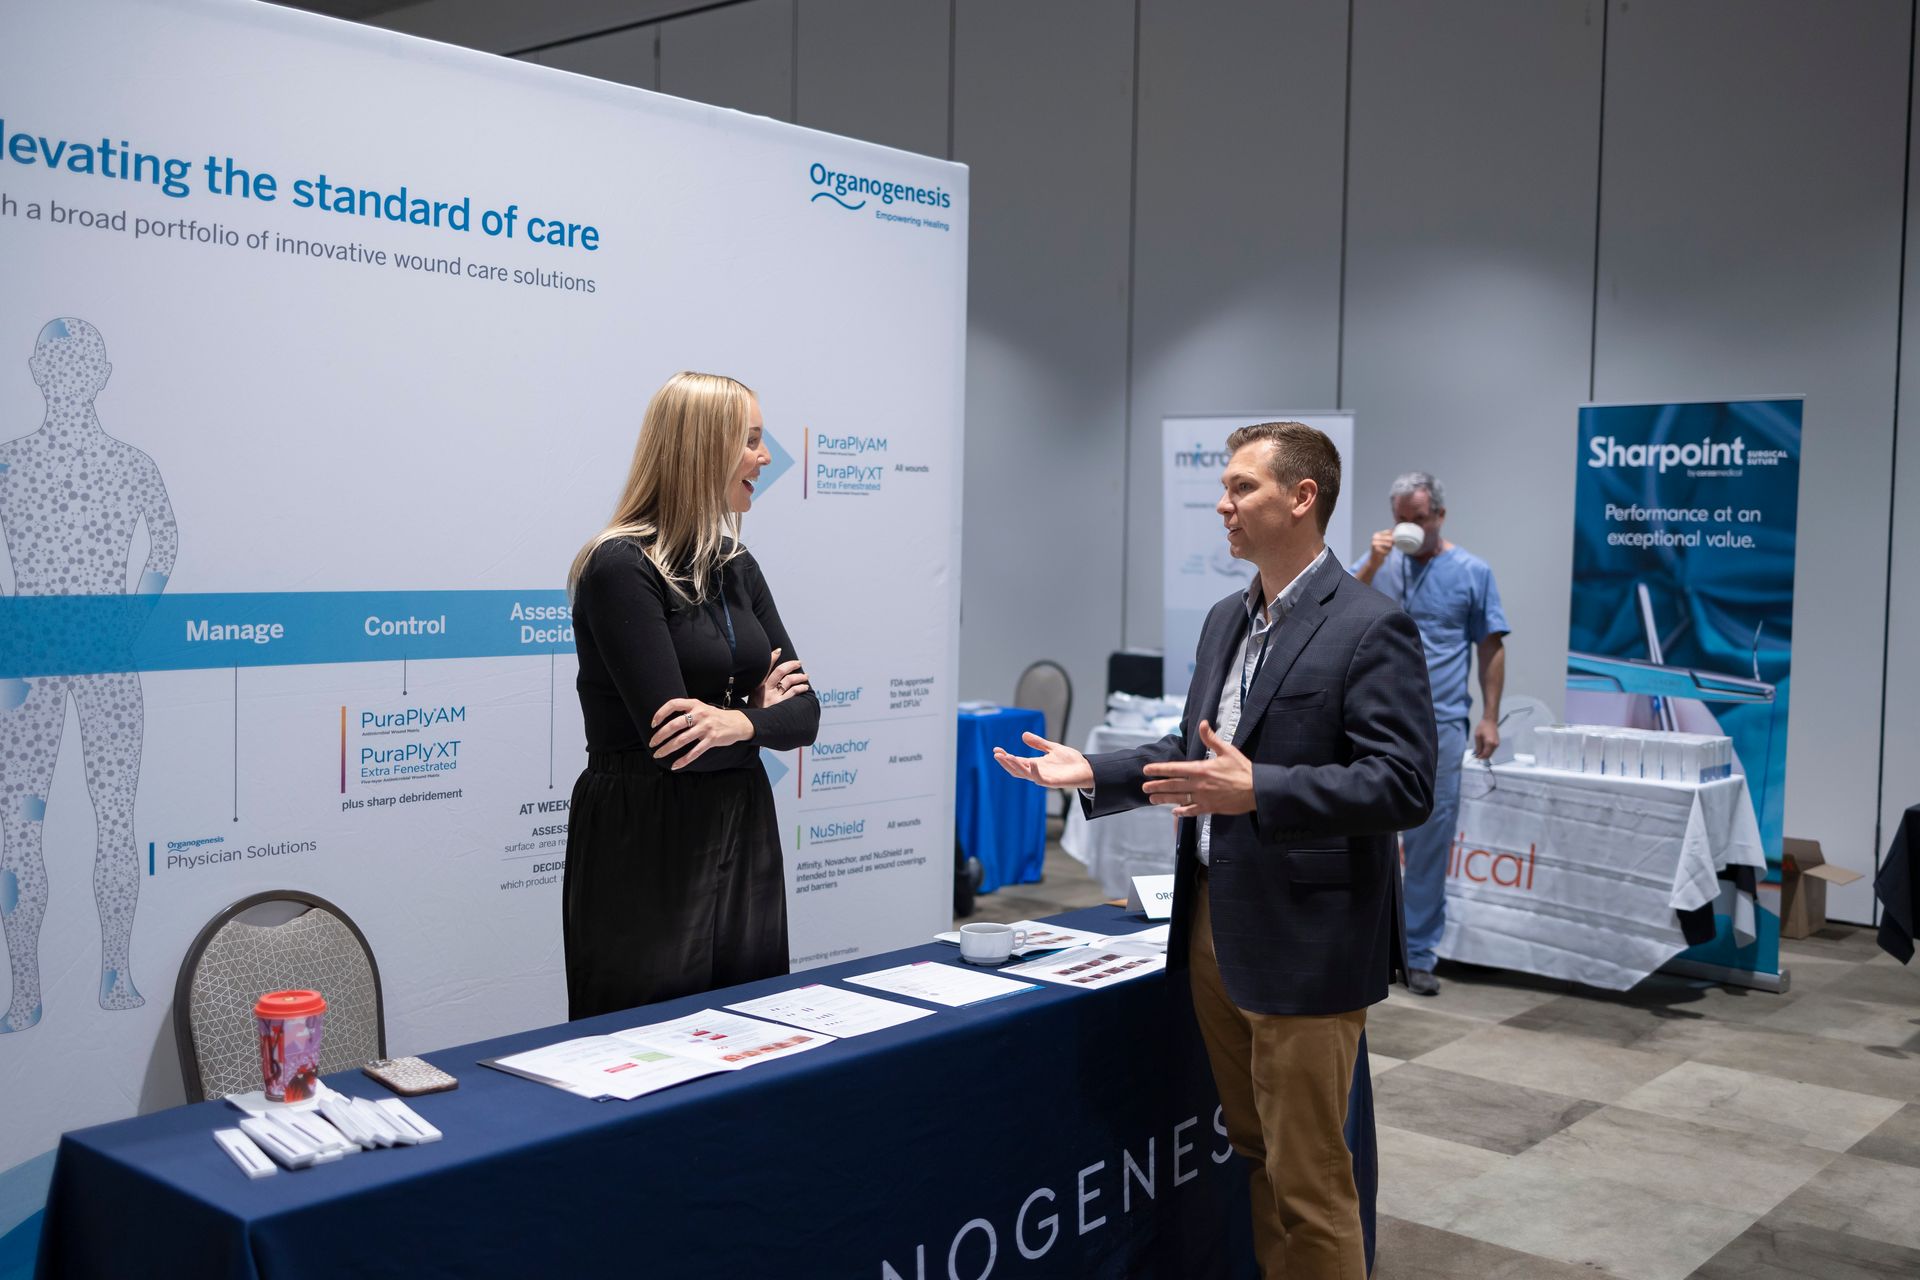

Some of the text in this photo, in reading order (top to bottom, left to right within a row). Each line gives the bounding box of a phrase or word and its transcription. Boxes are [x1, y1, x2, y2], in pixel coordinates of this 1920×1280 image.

[810, 163, 950, 208] Organogenesis
[204, 156, 277, 201] the
[292, 174, 470, 232] standard
[481, 205, 518, 239] of
[527, 217, 599, 251] care
[876, 210, 950, 232] Empowering Healing
[26, 203, 41, 220] a
[51, 200, 126, 232] broad
[135, 217, 239, 247] portfolio
[246, 230, 270, 252] of
[276, 235, 387, 265] innovative
[394, 252, 461, 276] wound
[467, 262, 508, 281] care
[514, 268, 597, 293] solutions
[1588, 436, 1745, 473] Sharpoint
[1746, 450, 1788, 458] SURGICAL
[1746, 458, 1778, 466] SUTURE
[895, 464, 929, 473] All wounds
[816, 480, 881, 491] Extra Fenestrated
[1605, 504, 1761, 522] Performance at an
[1607, 530, 1755, 549] exceptional value.
[187, 618, 284, 644] Manage
[364, 615, 446, 636] Control
[816, 687, 861, 704] Apligraf
[811, 739, 869, 756] Novachor
[888, 753, 923, 764] All wounds
[360, 760, 457, 779] Extra Fenestrated
[811, 770, 857, 786] Affinity
[342, 788, 463, 812] plus sharp debridement
[520, 800, 571, 815] AT WEEK
[532, 825, 568, 837] ASSESS
[810, 820, 864, 840] NuShield
[887, 818, 921, 829] All wounds
[167, 835, 224, 850] Organogenesis
[504, 842, 535, 853] surface
[539, 840, 556, 849] area
[168, 841, 317, 870] Physician Solutions
[859, 853, 872, 862] and
[873, 848, 902, 860] NuShield
[904, 847, 914, 855] are
[1446, 832, 1536, 890] ical
[796, 871, 827, 882] intended
[837, 868, 846, 876] be
[847, 865, 863, 874] used
[874, 861, 895, 870] wound
[896, 857, 926, 867] coverings
[500, 880, 524, 891] which
[526, 875, 557, 888] product
[796, 881, 838, 894] and barriers
